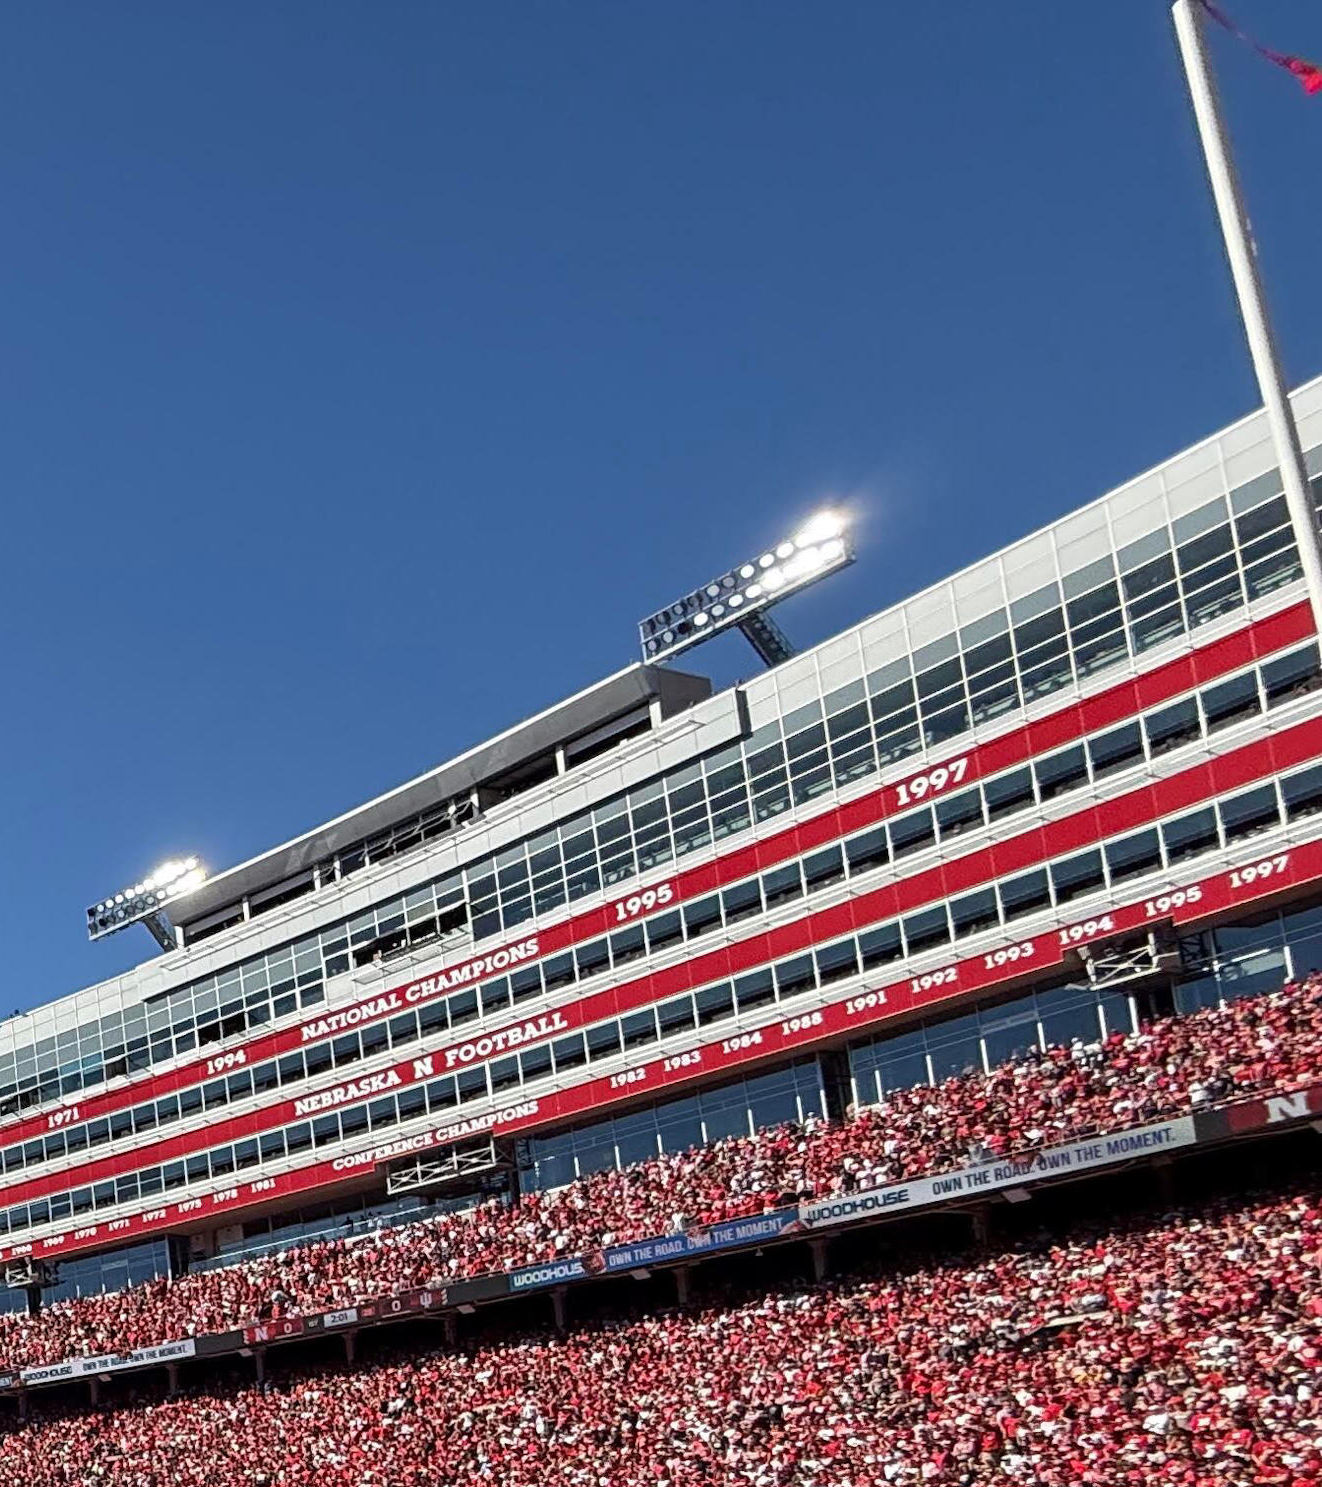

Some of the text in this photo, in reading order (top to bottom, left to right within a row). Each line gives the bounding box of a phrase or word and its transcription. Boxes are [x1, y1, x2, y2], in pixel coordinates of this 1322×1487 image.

[47, 1106, 80, 1129] 1971
[206, 1049, 247, 1076] 1994
[300, 992, 402, 1042] NATIONAL
[403, 938, 540, 1004] CHAMPIONS
[614, 883, 674, 922] 1995
[895, 757, 969, 807] 1997
[74, 1228, 97, 1240] 1970
[108, 1219, 131, 1232] 1971
[142, 1209, 167, 1223] 1972
[213, 1189, 239, 1204] 1978
[250, 1178, 277, 1194] 1981
[331, 1132, 434, 1172] CONFERENCE
[435, 1101, 539, 1145] CHAMPIONS
[609, 1067, 647, 1089] 1982
[662, 1050, 702, 1072] 1983
[721, 1033, 763, 1055] 1984
[781, 1012, 823, 1035] 1988
[845, 990, 887, 1015] 1991
[910, 967, 958, 993] 1992
[984, 942, 1035, 970] 1993
[1058, 916, 1114, 945] 1994
[1144, 886, 1202, 917] 1995
[1228, 855, 1290, 888] 1997
[294, 1012, 569, 1117] NEBRASKA N FOOTBALL
[1264, 1091, 1312, 1124] N
[931, 1176, 964, 1197] OWN
[965, 1170, 991, 1190] THE
[1037, 1149, 1072, 1172] OWN
[1074, 1142, 1103, 1164] THE
[1106, 1125, 1177, 1158] MOMENT.
[807, 1188, 911, 1225] WOODHOUSE
[608, 1250, 632, 1268] OWN
[633, 1245, 654, 1263] THE
[714, 1227, 735, 1244] THE
